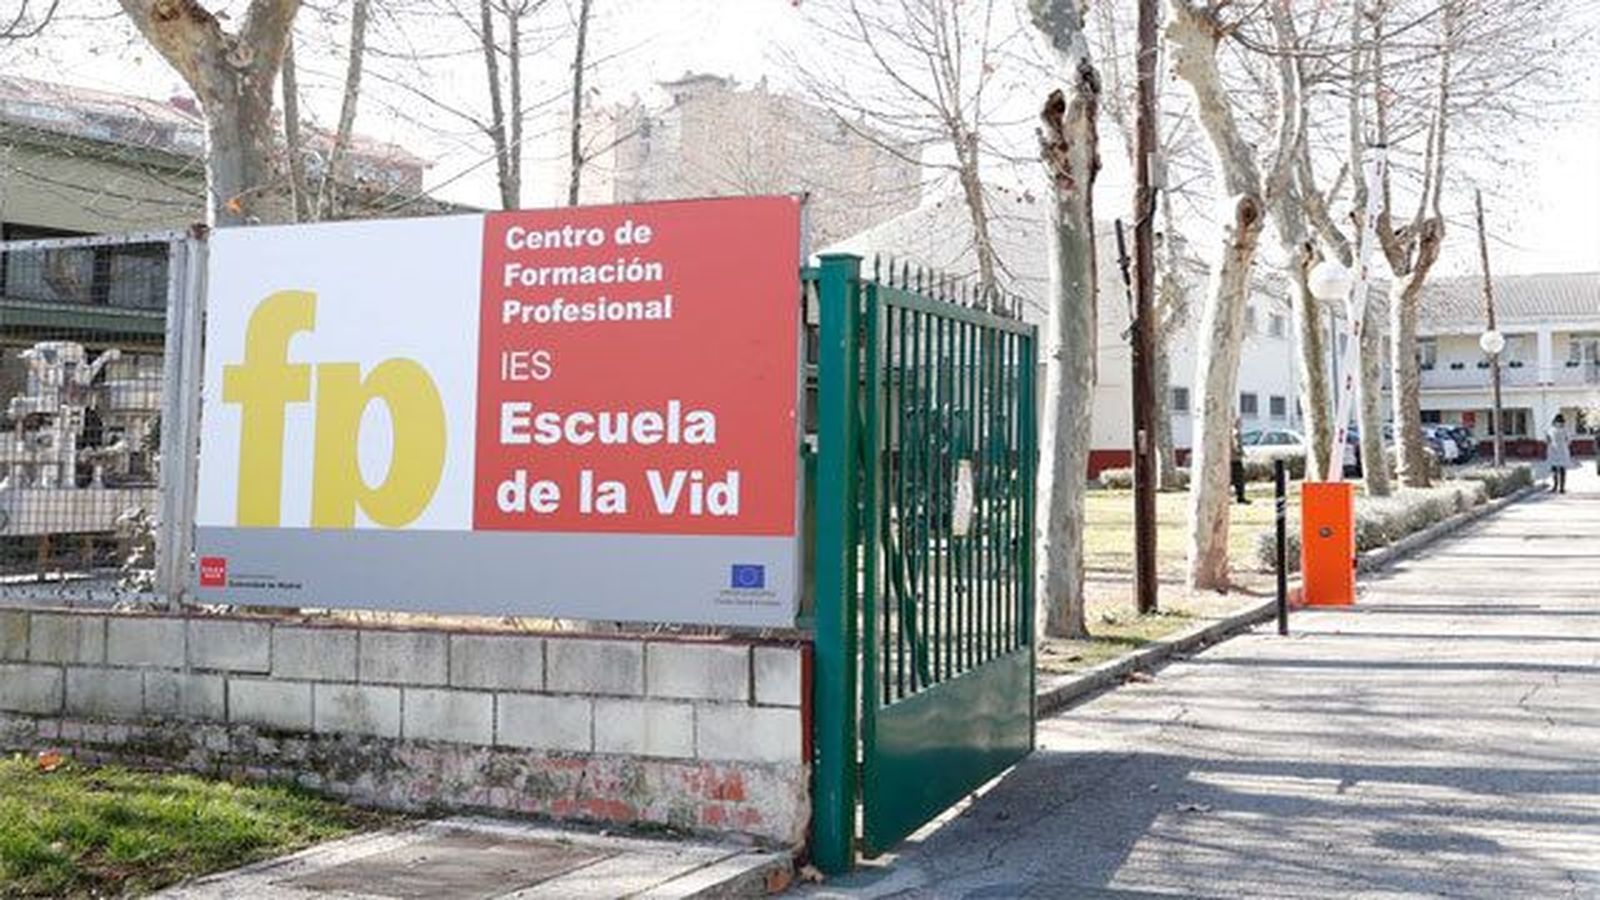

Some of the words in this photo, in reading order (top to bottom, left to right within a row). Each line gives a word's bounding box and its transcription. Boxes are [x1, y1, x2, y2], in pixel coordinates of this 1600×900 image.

[505, 224, 604, 250] Centro
[614, 220, 652, 245] de
[503, 257, 663, 287] Formación
[502, 294, 672, 324] Profesional
[501, 350, 552, 380] IES
[222, 290, 447, 530] fp
[499, 400, 717, 445] Escuela
[496, 469, 561, 513] de
[580, 469, 627, 514] la
[645, 470, 740, 516] Vid
